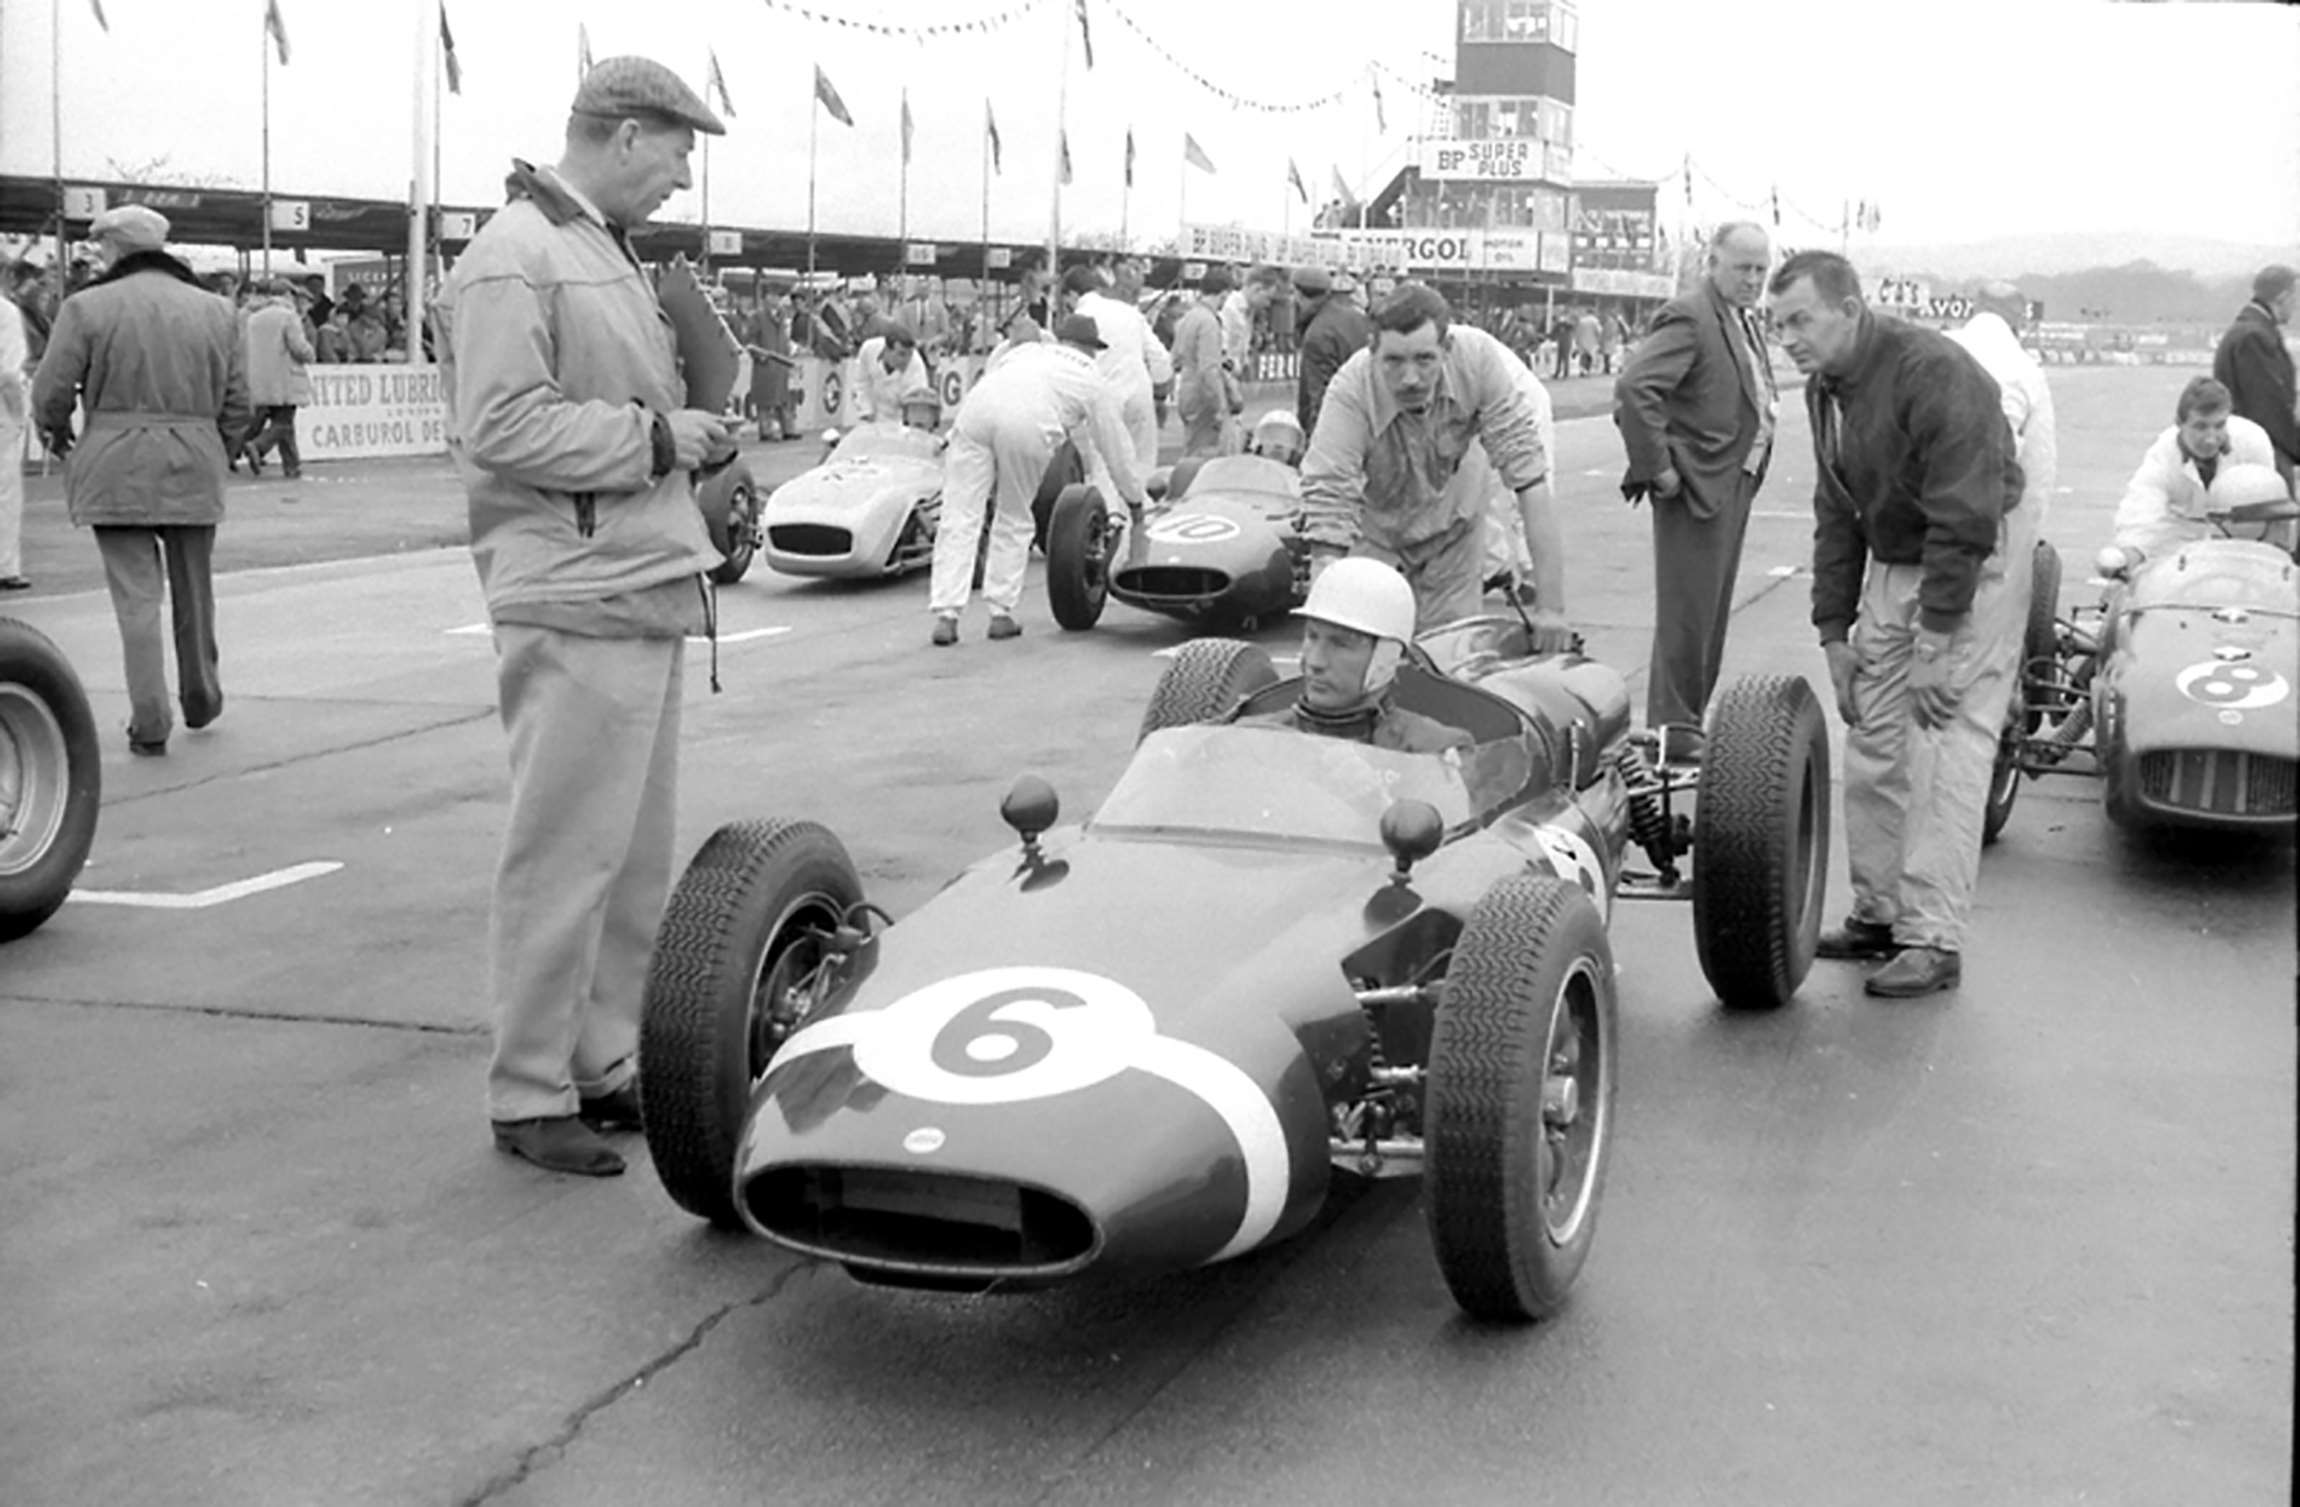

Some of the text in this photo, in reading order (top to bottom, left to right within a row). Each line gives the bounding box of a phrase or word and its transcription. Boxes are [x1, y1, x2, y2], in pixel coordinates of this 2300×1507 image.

[1438, 149, 1466, 171] BP
[1468, 142, 1528, 160] SUPER
[1478, 160, 1522, 177] PLUS
[462, 217, 472, 236] 7
[312, 421, 414, 447] CARBUROL
[1155, 514, 1236, 539] 10
[2187, 664, 2277, 702] 8
[930, 986, 1088, 1078] 6
